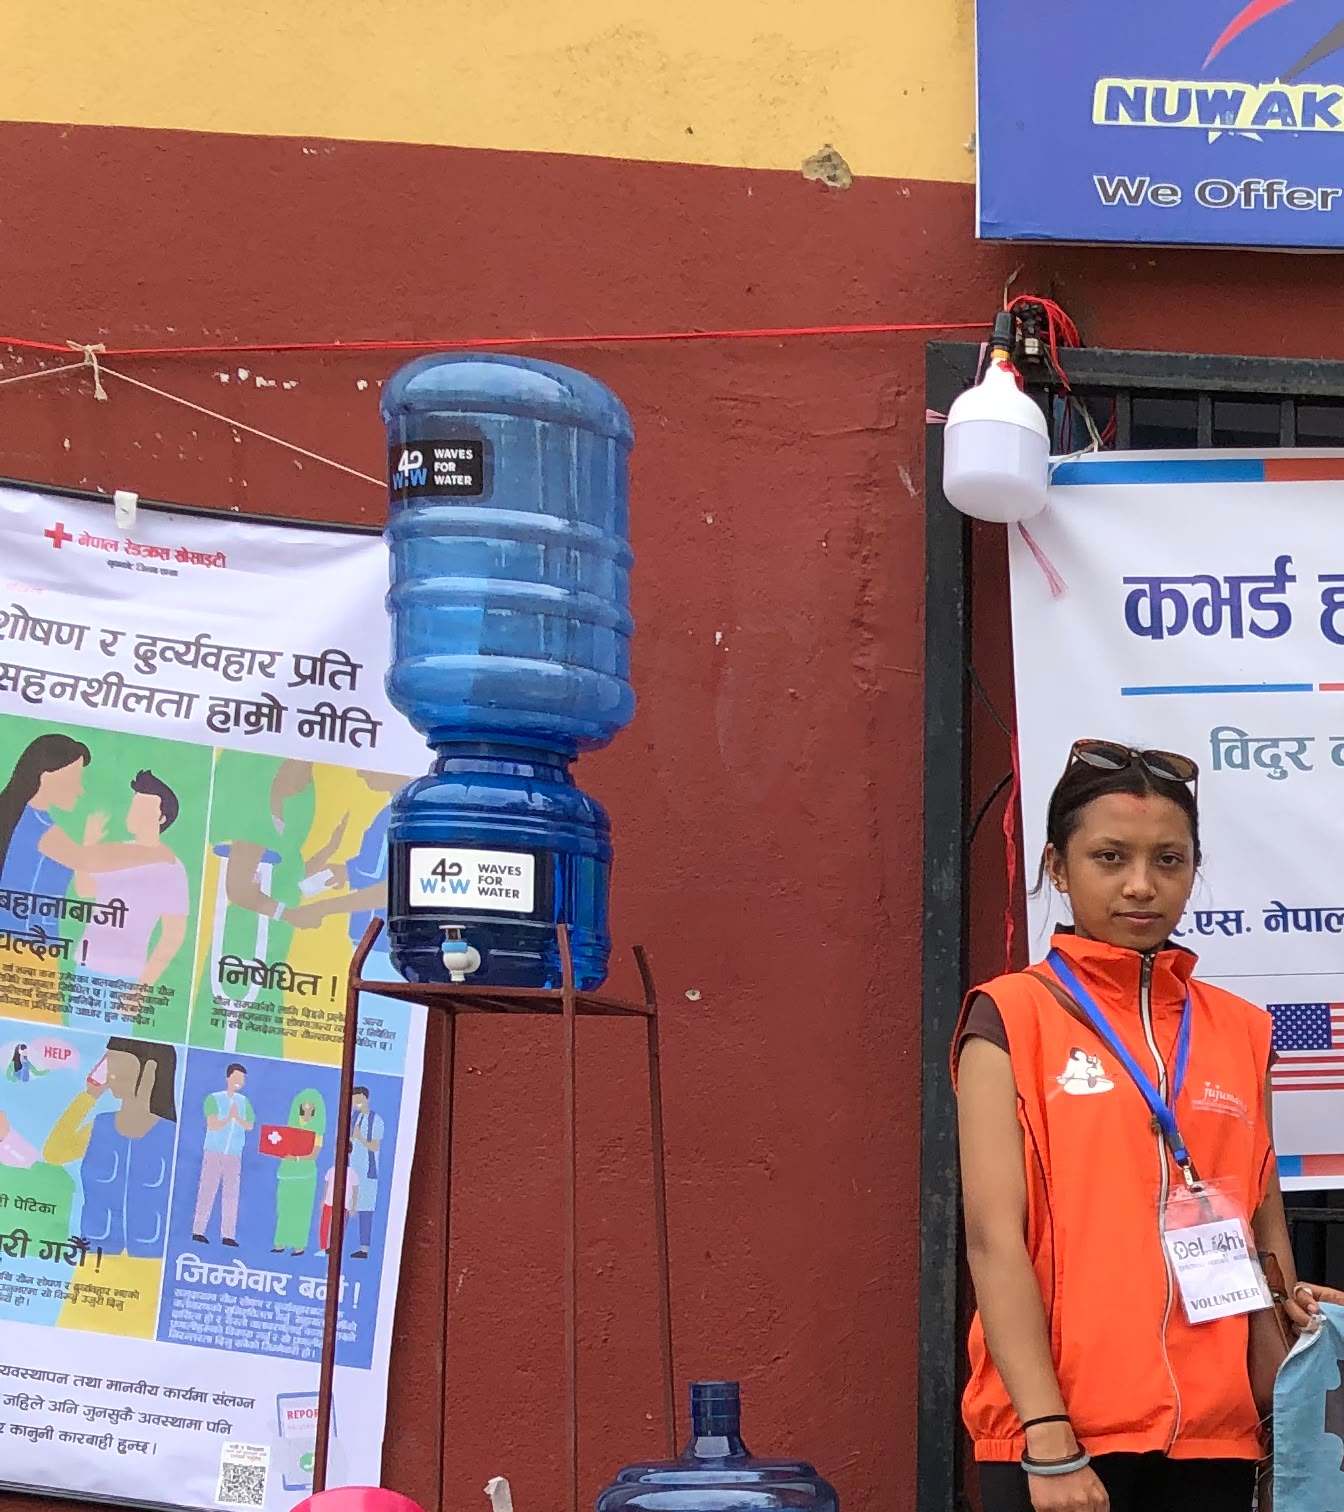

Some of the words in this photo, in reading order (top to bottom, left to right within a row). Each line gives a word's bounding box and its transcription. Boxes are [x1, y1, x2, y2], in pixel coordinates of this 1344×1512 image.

[1095, 174, 1183, 208] We
[1195, 175, 1341, 213] Offer
[433, 448, 474, 460] WAVES
[433, 461, 457, 473] FOR
[433, 474, 473, 486] WATER
[1121, 554, 1297, 642] कभर्ड
[99, 628, 126, 657] र
[133, 633, 284, 682] दुर्व्यवहार
[287, 648, 363, 691] प्रति
[206, 692, 288, 735] हाम्रो
[297, 700, 383, 748] नीति
[1209, 725, 1316, 780] विदुर
[477, 863, 523, 877] WAVES
[477, 875, 504, 887] FOR
[477, 886, 521, 899] WATER
[219, 954, 322, 996] निषेधित
[43, 1046, 72, 1060] HELP
[175, 1253, 293, 1296] जिम्मेवार
[1190, 1287, 1261, 1311] VOLUNTEER
[73, 1374, 103, 1390] तथा
[106, 1379, 159, 1397] मानवीय
[163, 1386, 209, 1403] कार्यमा
[48, 1399, 79, 1415] अनि
[207, 1419, 233, 1436] पनि
